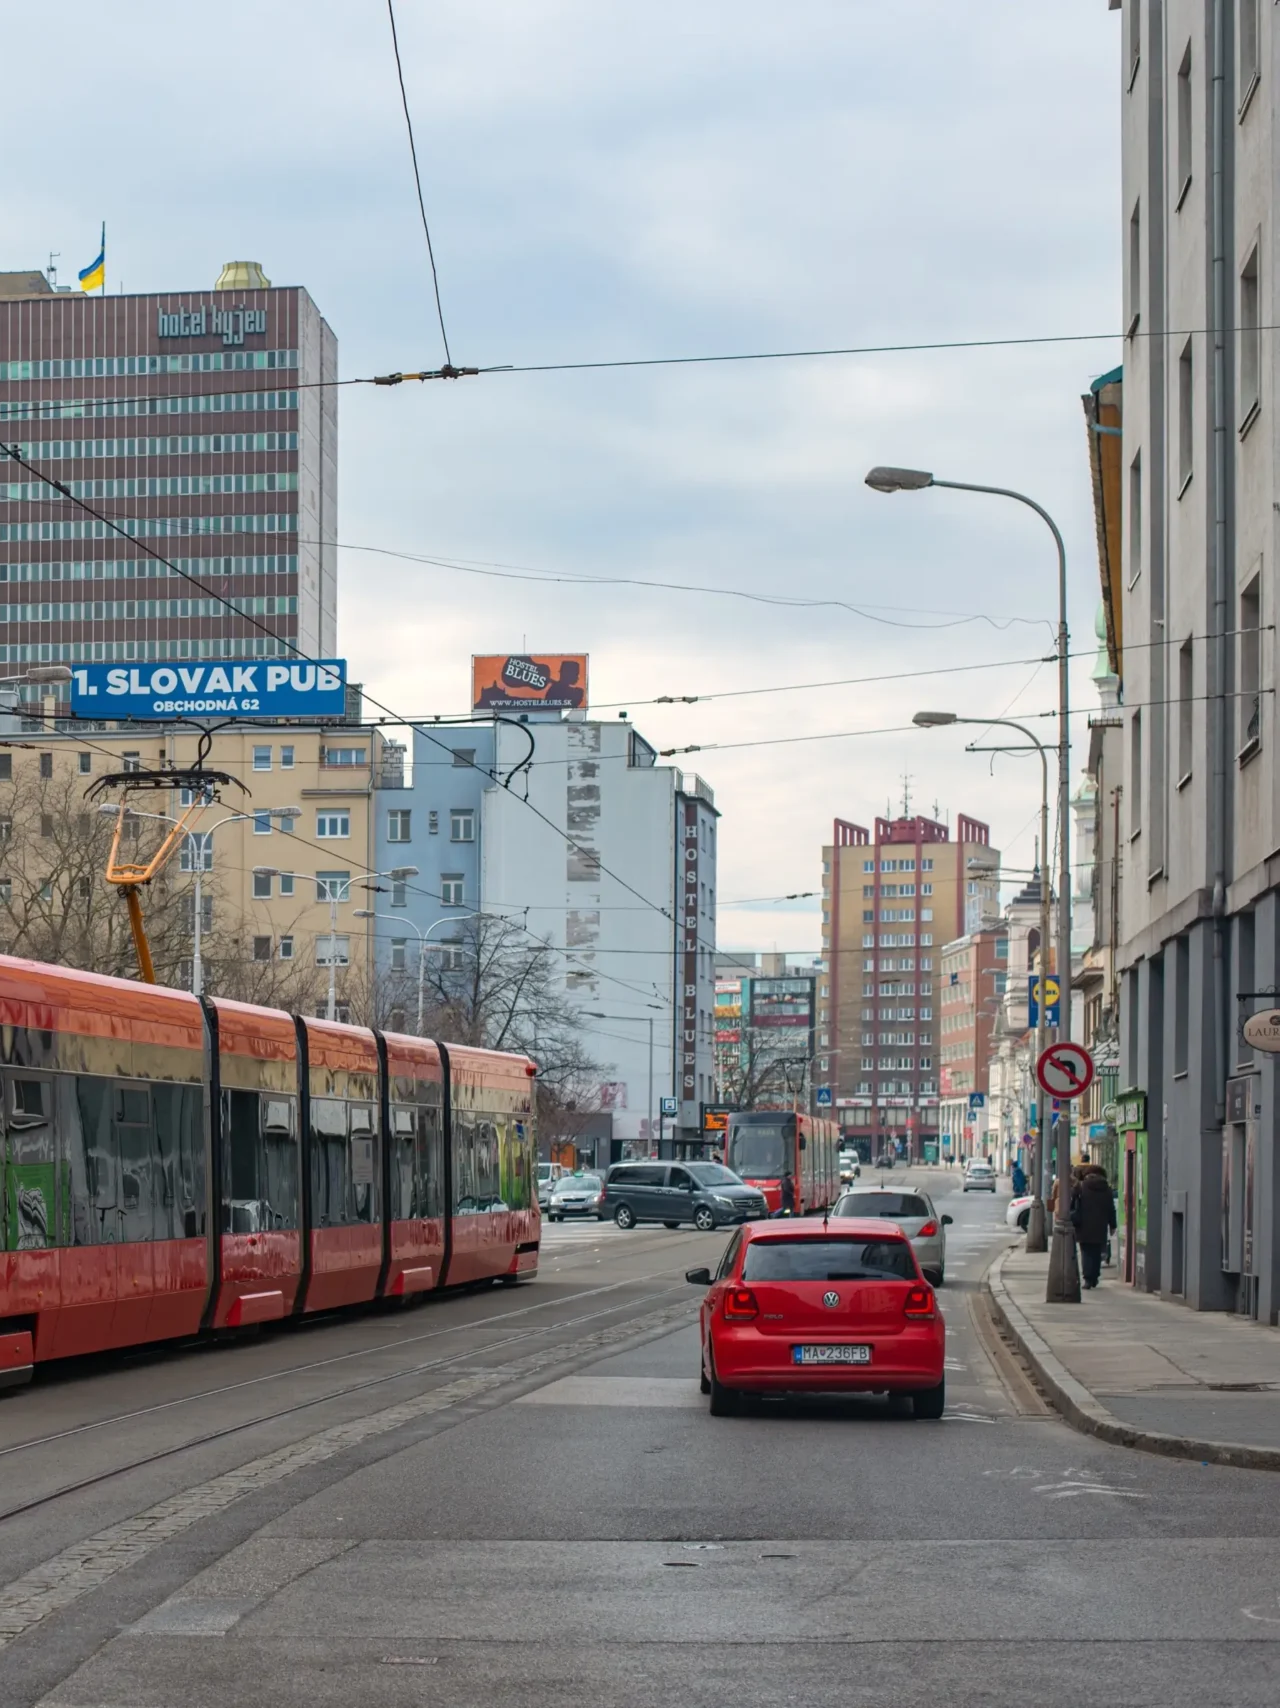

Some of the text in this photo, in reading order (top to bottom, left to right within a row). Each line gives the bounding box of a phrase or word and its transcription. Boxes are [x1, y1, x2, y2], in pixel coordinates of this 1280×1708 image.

[158, 305, 206, 337] hotel
[505, 665, 547, 688] BLUES
[510, 658, 539, 674] HOSTEL
[74, 664, 341, 696] 1. SLOVAK PUB
[153, 696, 260, 712] OBCHODNÁ 62
[684, 825, 698, 1088] HOSTEL BLUES
